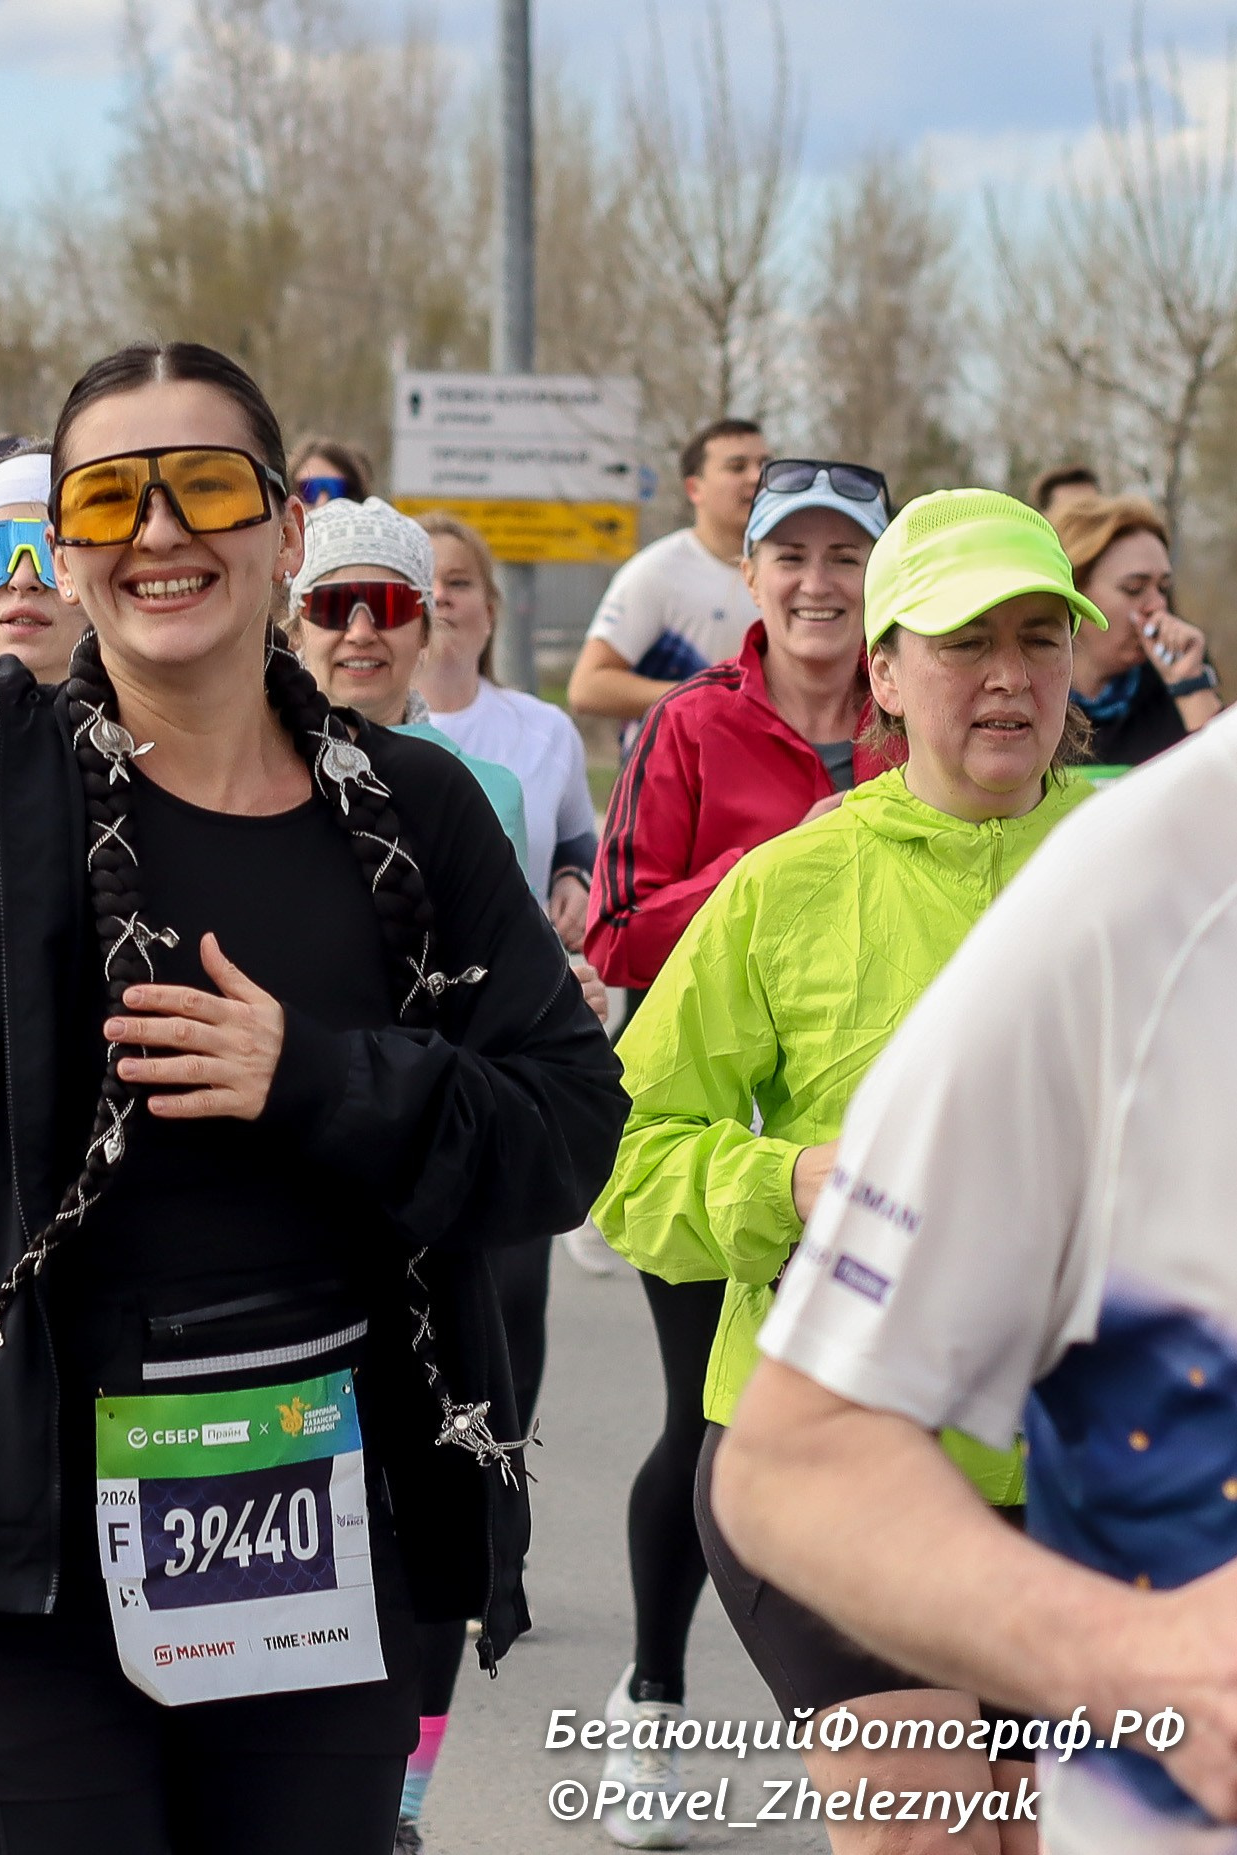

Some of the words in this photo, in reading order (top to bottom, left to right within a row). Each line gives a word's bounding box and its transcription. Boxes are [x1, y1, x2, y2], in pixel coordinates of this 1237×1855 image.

[152, 1429, 199, 1445] СБЕР
[207, 1428, 242, 1441] Прайм
[100, 1490, 137, 1506] 2026
[107, 1522, 131, 1563] F
[163, 1487, 320, 1578] 39440
[175, 1640, 236, 1660] МАГНИТ
